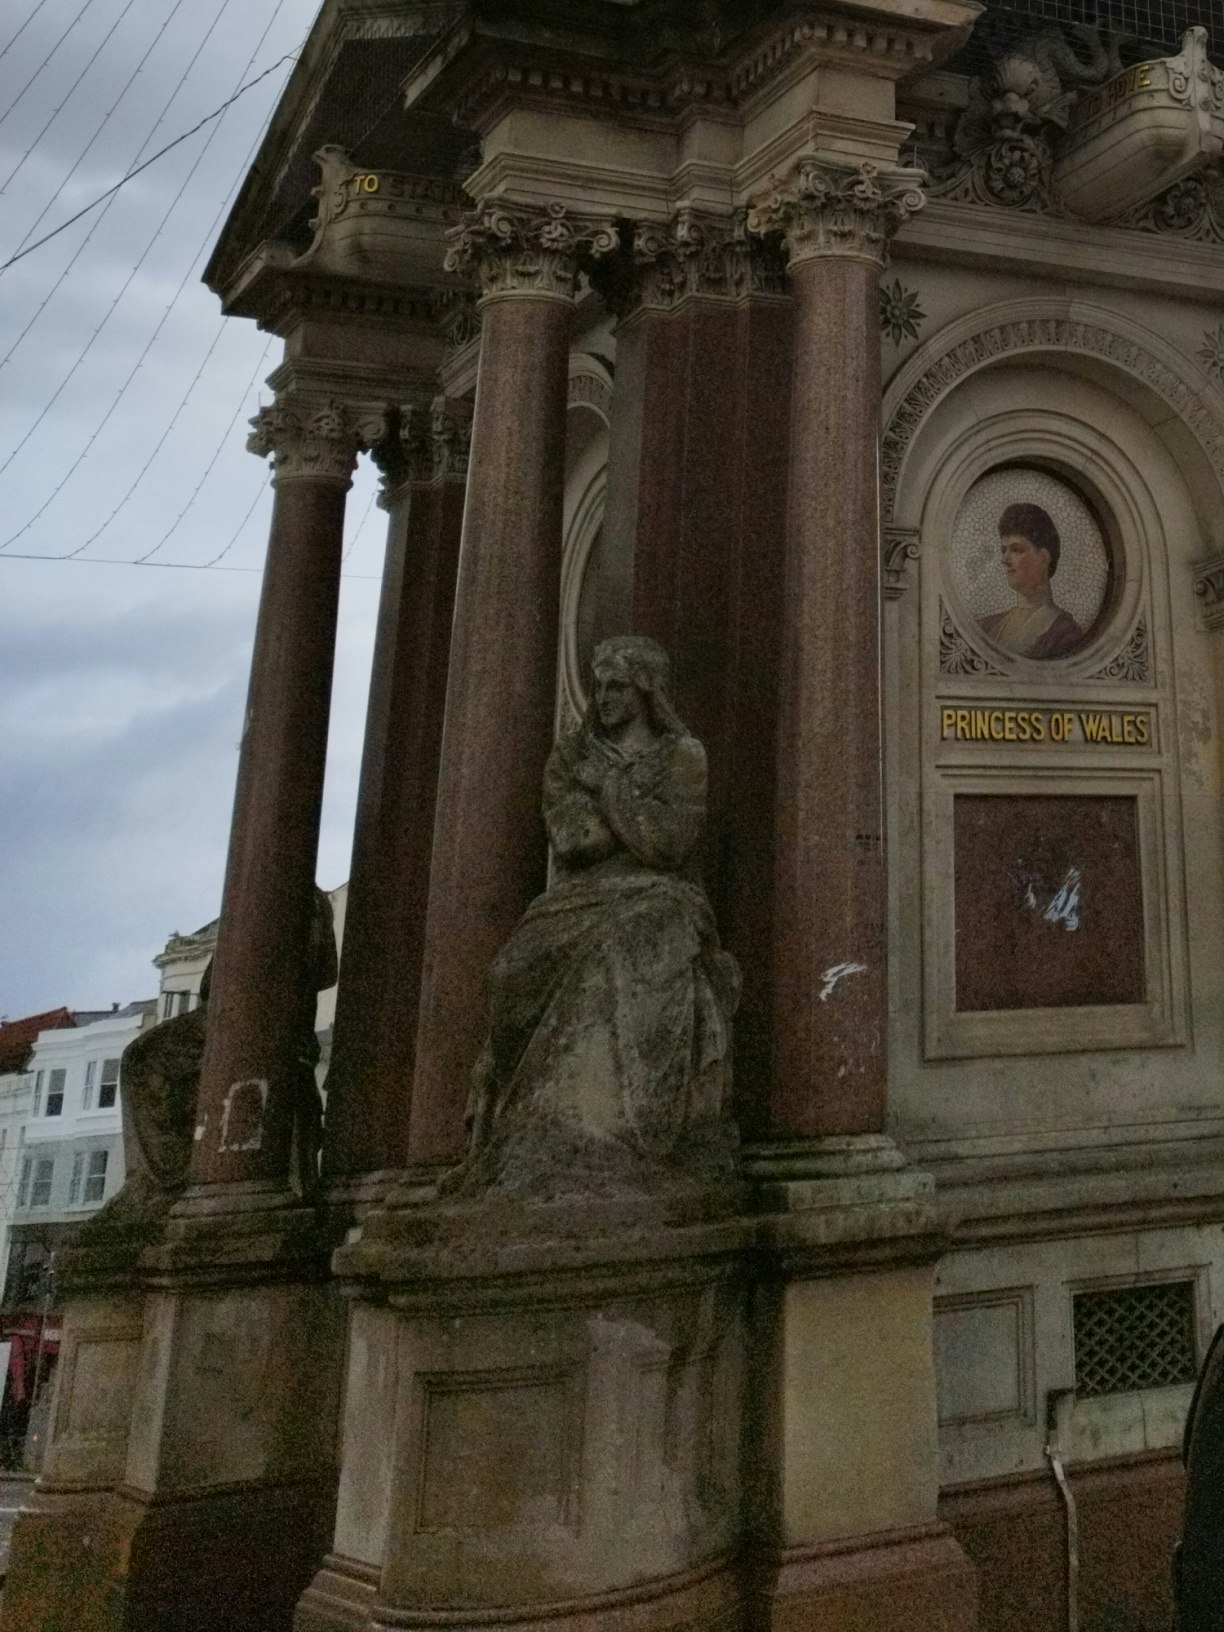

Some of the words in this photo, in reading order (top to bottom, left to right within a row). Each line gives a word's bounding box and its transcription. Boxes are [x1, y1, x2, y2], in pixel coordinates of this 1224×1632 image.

[354, 174, 379, 193] TO
[941, 709, 1045, 741] PRINCESS
[1051, 713, 1075, 741] OF
[1081, 713, 1149, 744] WALES
